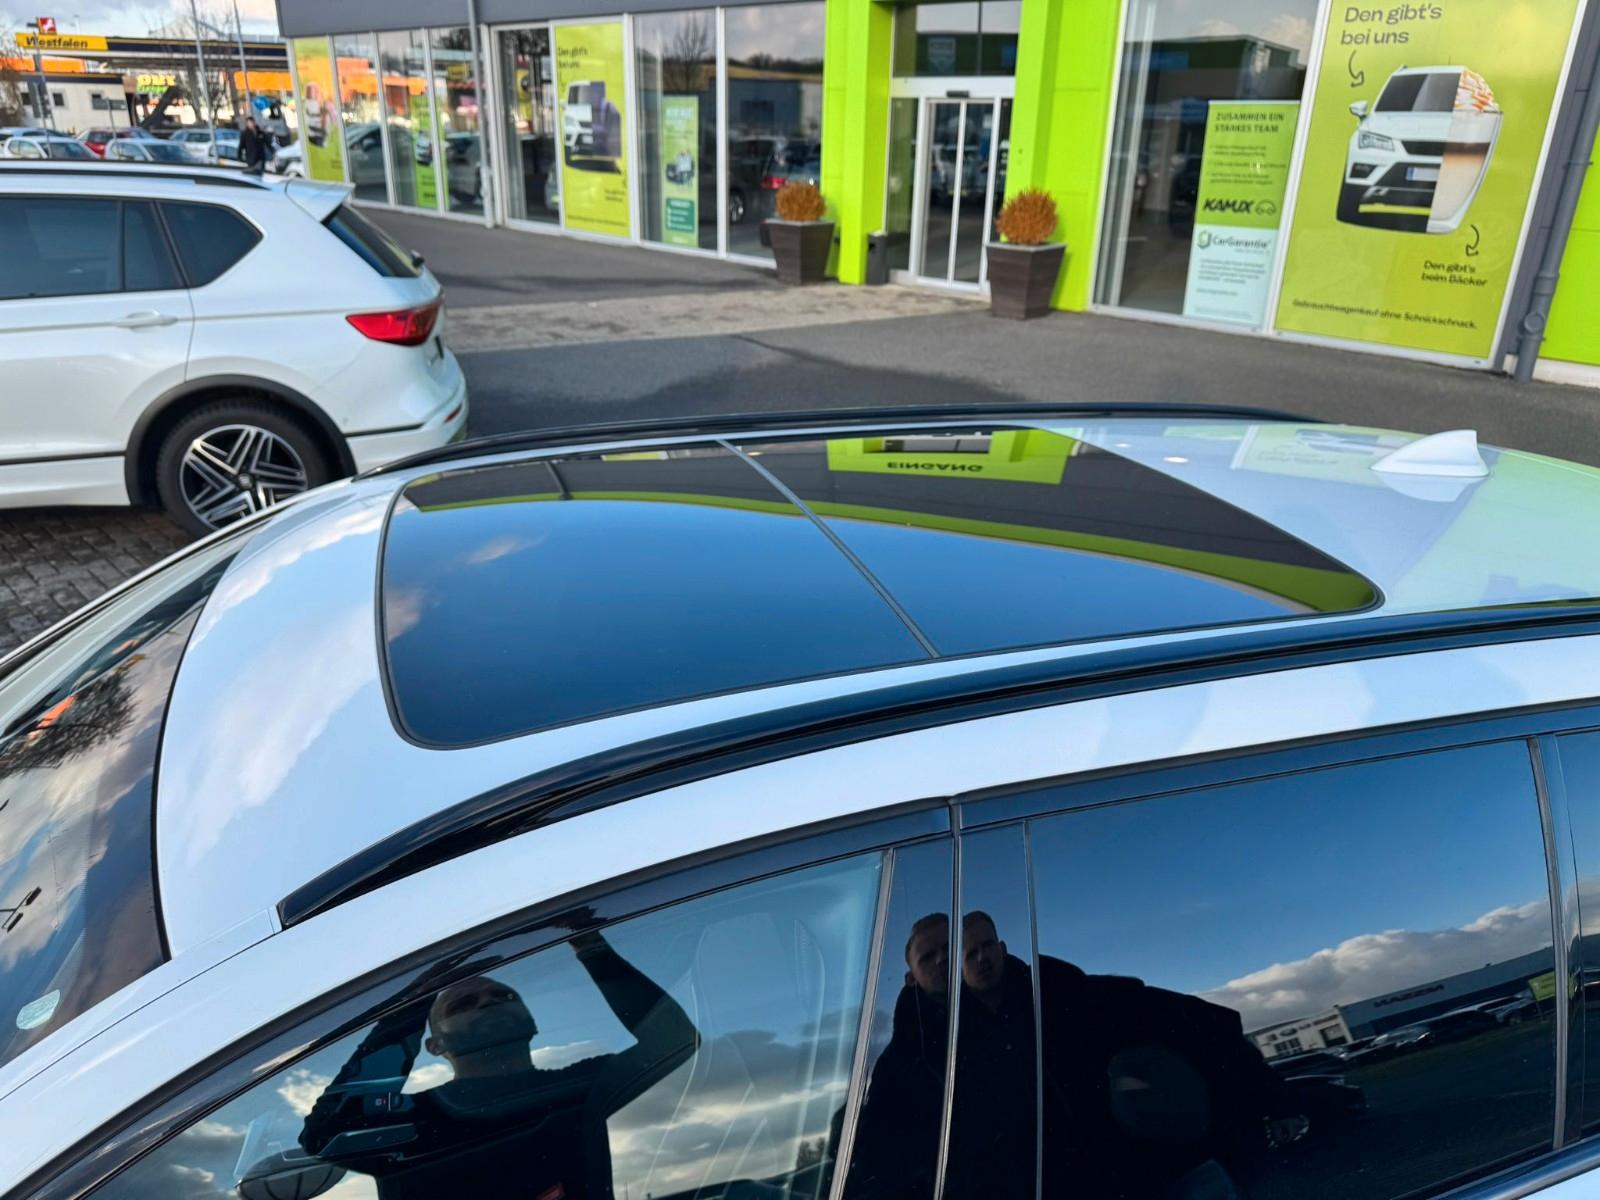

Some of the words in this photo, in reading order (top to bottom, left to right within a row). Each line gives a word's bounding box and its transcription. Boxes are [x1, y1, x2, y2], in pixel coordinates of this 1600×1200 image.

[1344, 6, 1384, 23] Den
[1385, 3, 1443, 25] gibt's
[26, 36, 89, 49] Westfalen
[1340, 28, 1372, 45] bei
[1373, 31, 1410, 44] uns
[1216, 112, 1267, 121] ZUSAMMEN
[1268, 113, 1285, 121] EIN
[1254, 125, 1280, 133] TEAM
[1203, 197, 1255, 213] KAMUX
[1424, 260, 1446, 271] Den
[1421, 271, 1448, 283] beim
